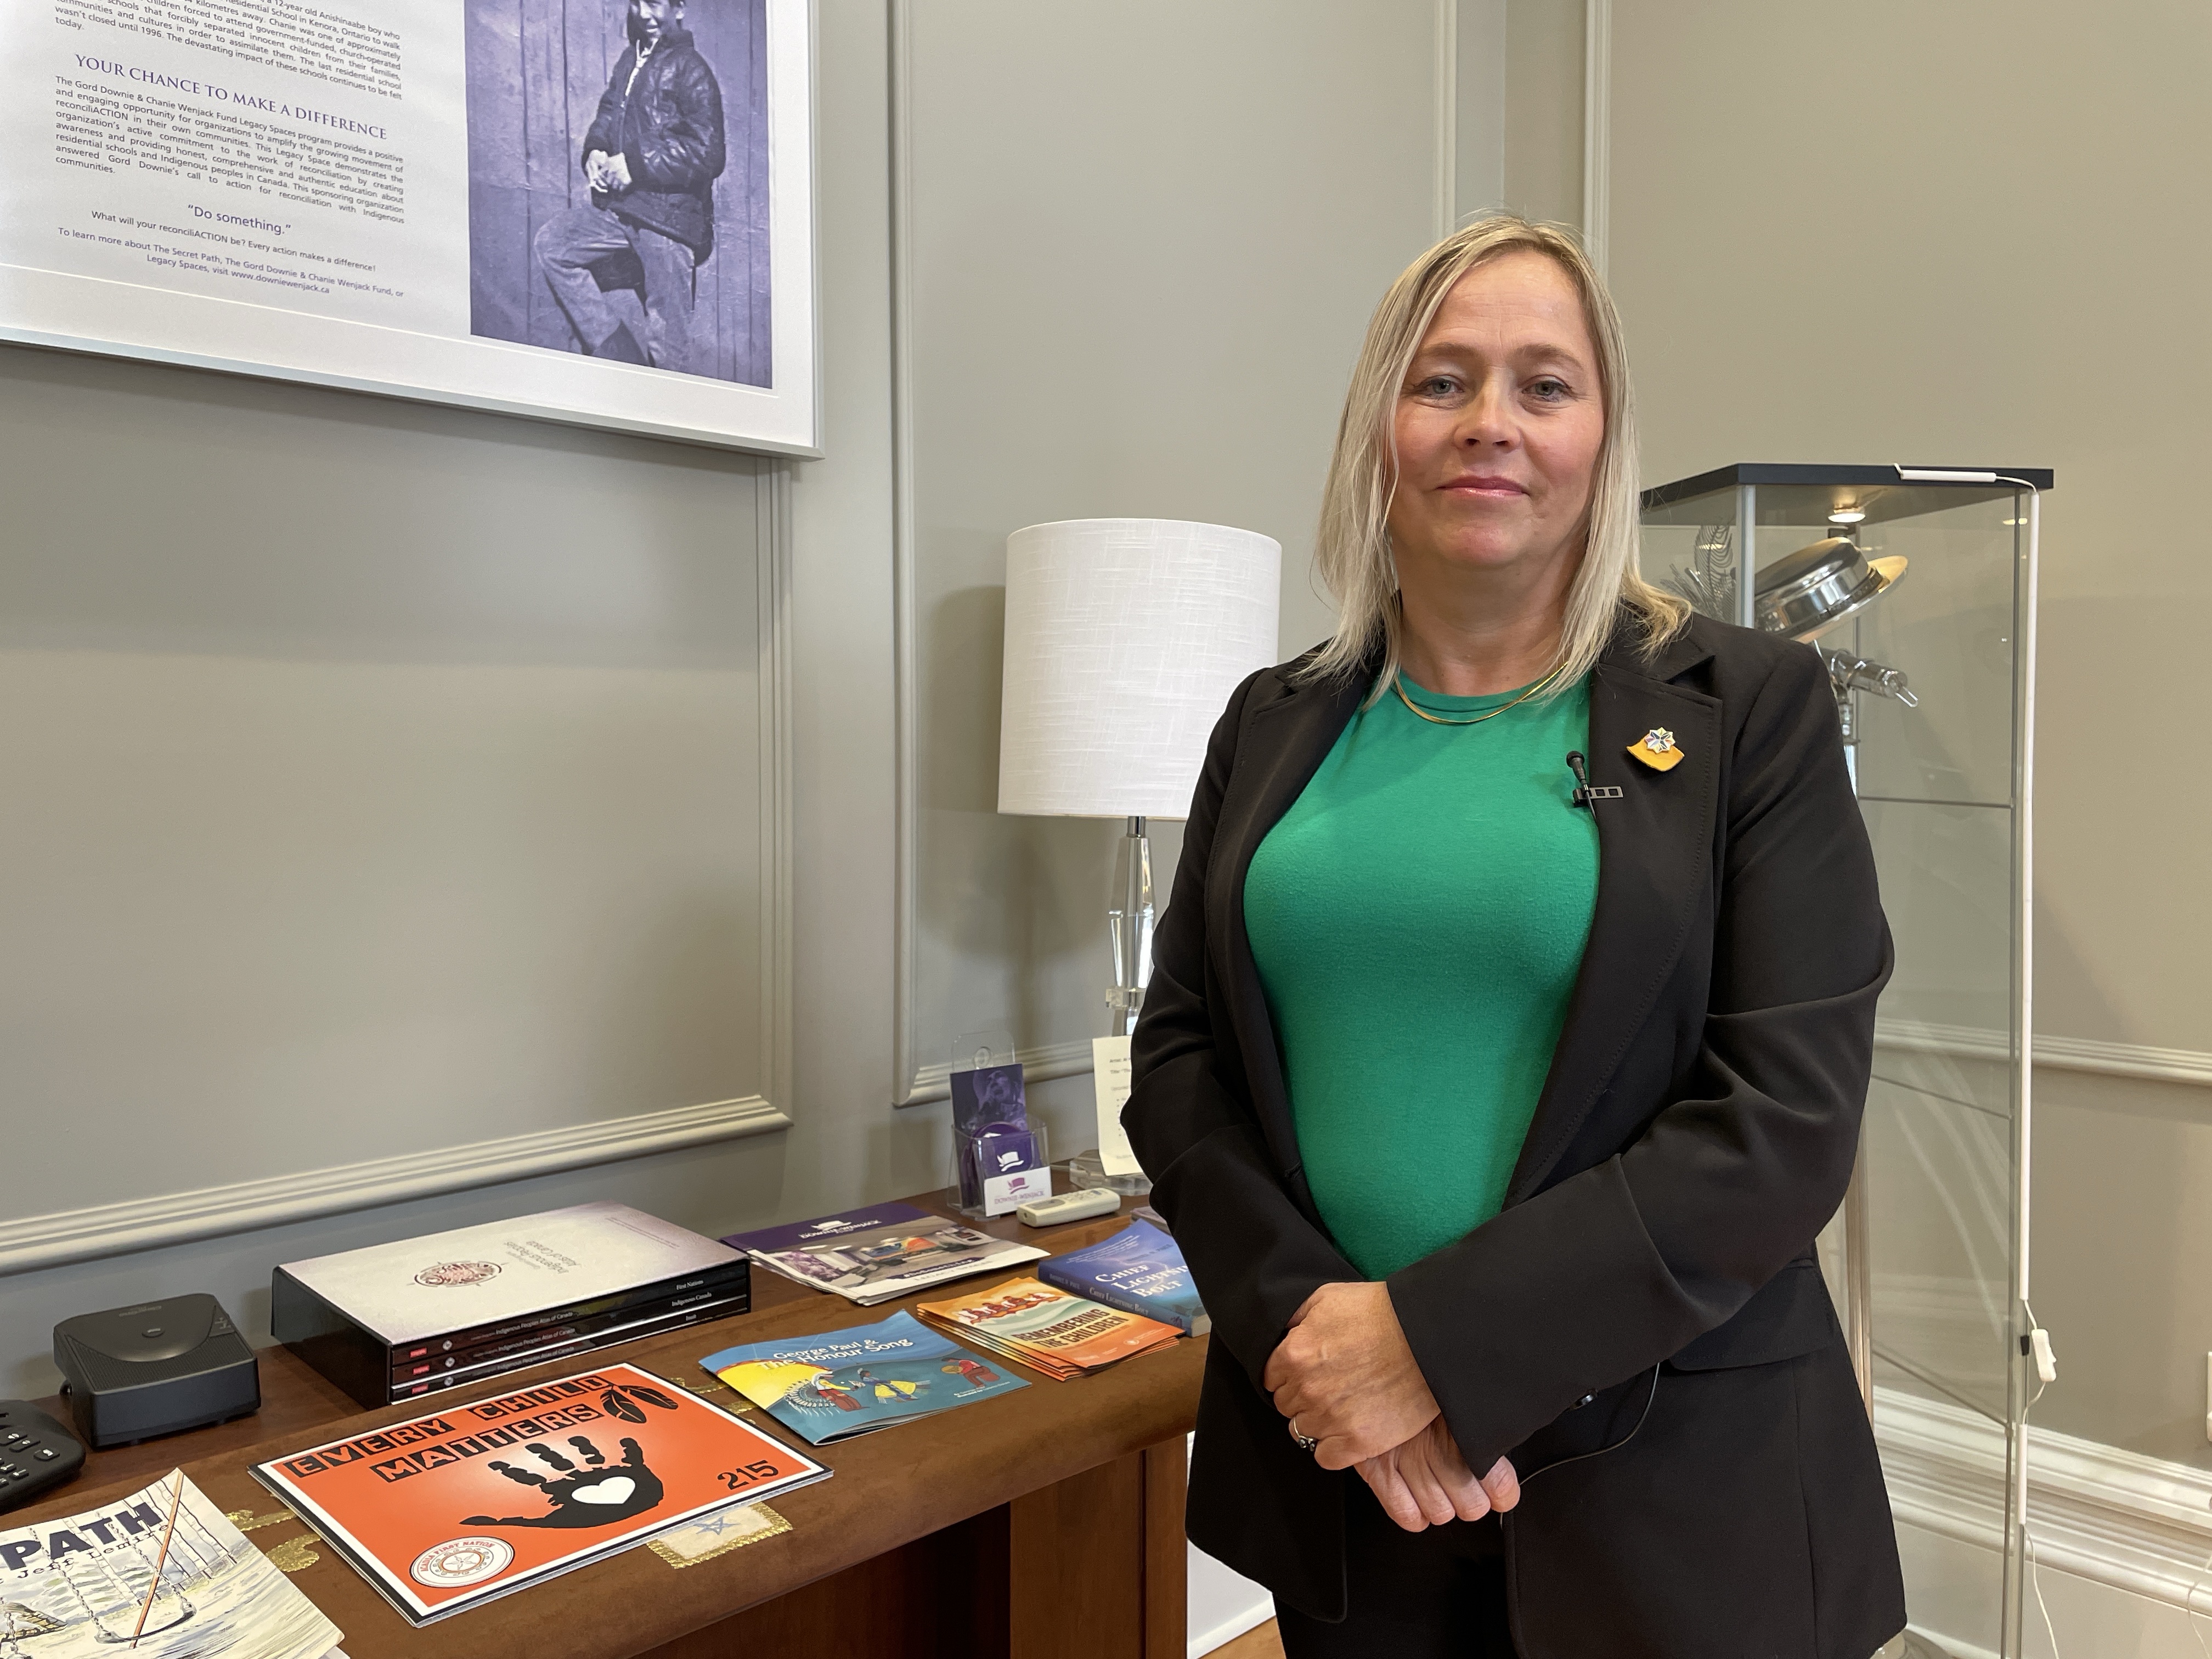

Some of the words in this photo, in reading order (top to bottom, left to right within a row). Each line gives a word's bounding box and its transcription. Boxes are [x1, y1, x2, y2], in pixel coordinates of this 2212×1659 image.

[88, 14, 116, 26] closed
[119, 22, 139, 32] until
[167, 32, 183, 43] The
[185, 37, 234, 57] devastating
[235, 50, 263, 64] impact
[276, 61, 298, 72] these
[300, 68, 328, 80] schools
[329, 76, 366, 91] continues
[378, 87, 388, 96] be
[390, 91, 403, 100] felt
[55, 76, 73, 86] The
[75, 81, 98, 92] Gord
[100, 86, 135, 100] Downie
[146, 96, 176, 109] Chanie
[178, 103, 214, 118] Wenjack
[217, 112, 238, 123] Fund
[240, 117, 268, 132] Legacy
[269, 125, 296, 137] Spaces
[298, 133, 332, 145] program
[334, 142, 367, 154] provides
[375, 152, 404, 163] positive
[76, 54, 125, 77] YOUR
[129, 68, 200, 94] CHANCE
[205, 86, 228, 100] TO
[233, 92, 276, 112] MAKE
[280, 104, 291, 116] A
[296, 107, 387, 139] DIFFERENCE
[55, 89, 74, 98] and
[77, 94, 120, 109] engaging
[123, 104, 176, 121] opportunity
[179, 114, 191, 123] for
[195, 120, 252, 137] organizations
[267, 136, 297, 149] amplify
[300, 143, 313, 152] the
[317, 148, 349, 162] growing
[352, 156, 392, 171] movement
[56, 100, 128, 121] reconciliACTION
[134, 115, 142, 123] in
[146, 119, 167, 129] their
[172, 126, 191, 134] own
[257, 143, 272, 153] This
[276, 148, 304, 161] Legacy
[308, 155, 331, 166] Space
[335, 162, 387, 179] demonstrates
[391, 175, 404, 183] the
[127, 126, 153, 137] active
[160, 134, 215, 150] commitment
[236, 150, 251, 159] the
[257, 155, 279, 165] work
[300, 165, 352, 181] reconciliation
[358, 177, 368, 187] by
[373, 182, 404, 195] creating
[58, 227, 70, 236] To
[73, 229, 96, 241] learn
[98, 236, 122, 245] more
[125, 240, 151, 251] about
[154, 244, 170, 254] The
[172, 247, 199, 259] Secret
[201, 253, 223, 264] Path,
[226, 257, 241, 267] The
[243, 261, 264, 271] Gord
[267, 265, 298, 278] Downie
[308, 273, 335, 284] Chanie
[337, 279, 370, 291] Wenjack
[373, 285, 394, 296] Fund,
[92, 211, 116, 222] What
[137, 221, 157, 229] your
[159, 225, 228, 243] reconciliACTION
[230, 236, 246, 246] be?
[248, 240, 271, 252] Every
[273, 247, 298, 256] action
[300, 252, 325, 262] makes
[334, 258, 376, 272] difference!
[147, 254, 177, 268] Legacy
[179, 260, 210, 273] Spaces,
[212, 267, 229, 275] visit
[231, 271, 330, 294] www.downiewenjack.ca
[1095, 1265, 1151, 1282] CHIEF
[1130, 1280, 1183, 1297] BOLT
[758, 1358, 797, 1371] The
[798, 1348, 864, 1365] Honour
[864, 1338, 915, 1355] Song
[773, 1346, 830, 1361] George
[828, 1340, 862, 1351] Paul
[864, 1339, 879, 1347] &
[1011, 1308, 1110, 1341] REMEMBERING
[1032, 1338, 1069, 1348] THE
[1059, 1316, 1130, 1343] CHILDREN
[284, 1418, 453, 1477] EVERY
[469, 1376, 614, 1420] CHILD
[371, 1404, 603, 1481] MATTERS
[717, 1460, 779, 1490] 215
[0, 1502, 163, 1571] PATH
[17, 1558, 75, 1579] Jeff
[86, 1524, 169, 1560] Lemire
[433, 1542, 460, 1555] FIRST
[462, 1541, 495, 1549] NATION
